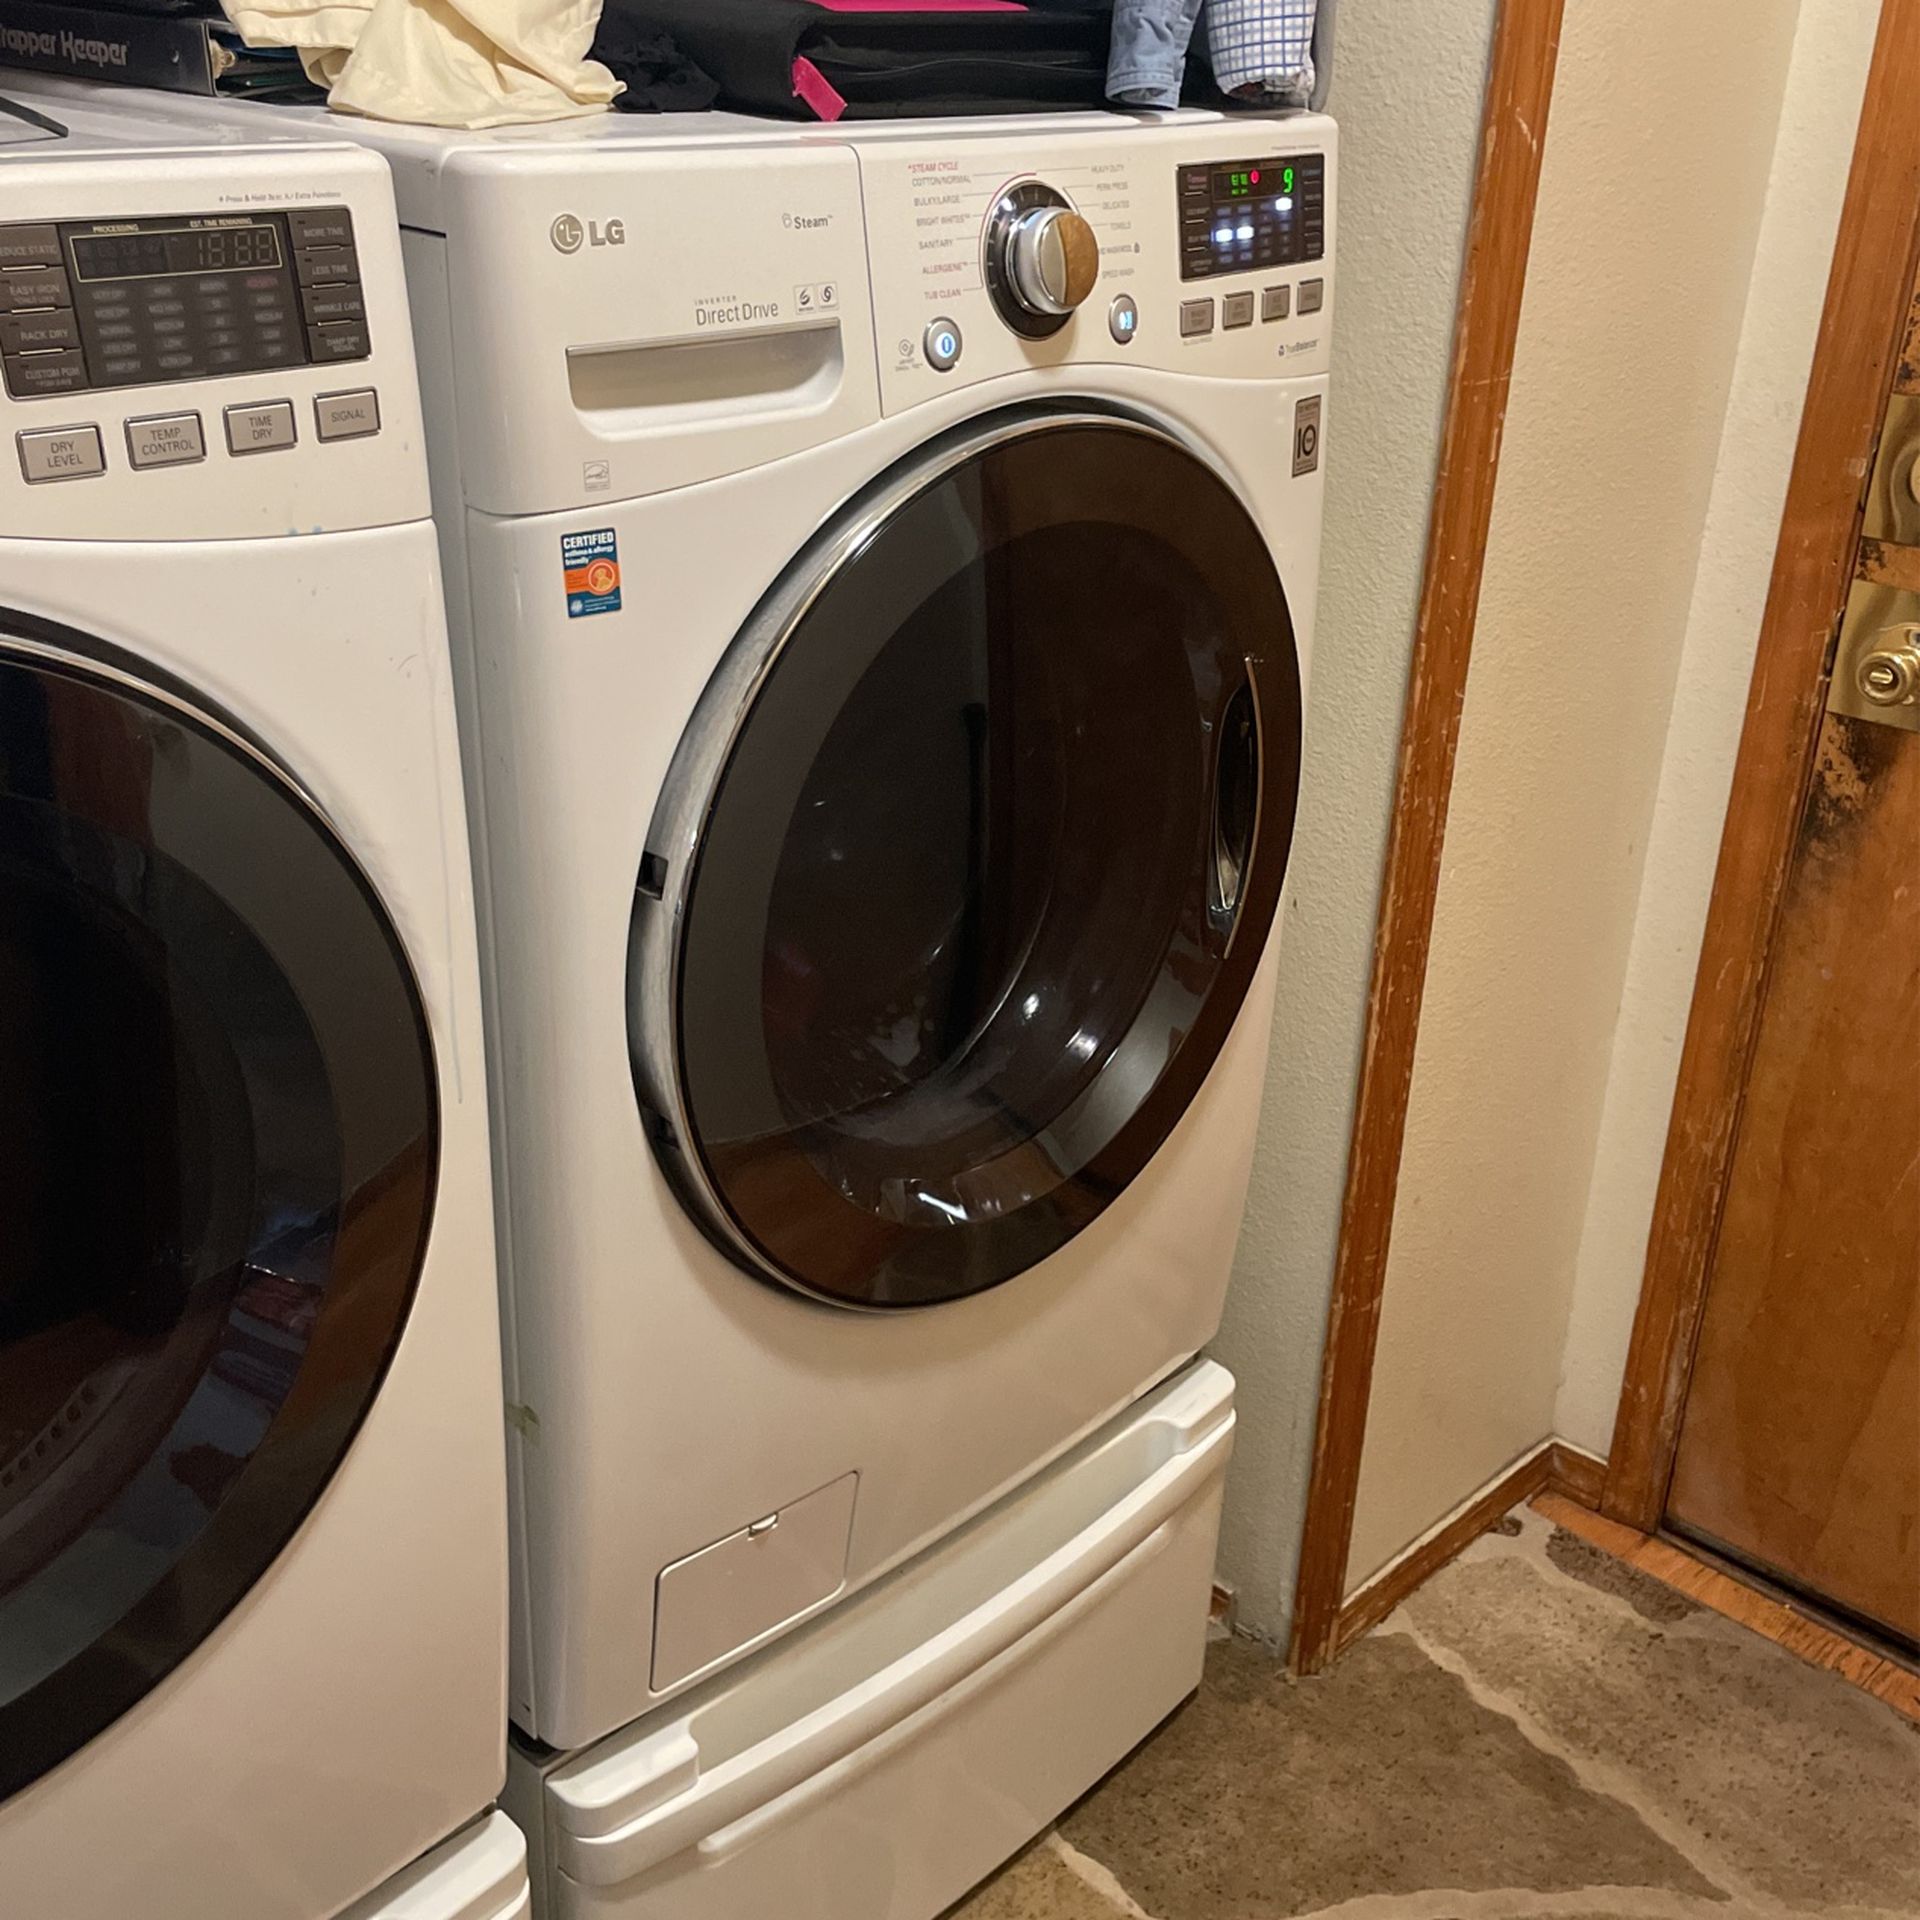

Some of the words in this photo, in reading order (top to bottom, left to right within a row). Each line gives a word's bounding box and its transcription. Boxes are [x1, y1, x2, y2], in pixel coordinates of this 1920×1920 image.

[0, 22, 56, 57] rapper
[60, 30, 127, 68] Keeper
[1283, 167, 1294, 193] 9
[589, 219, 625, 246] LG
[696, 305, 741, 326] Direct
[743, 301, 779, 321] Drive
[249, 415, 272, 428] TIME
[331, 408, 366, 423] SIGNAL
[151, 427, 181, 441] TEMP
[252, 428, 273, 441] DRY
[50, 441, 75, 454] DRY
[142, 440, 195, 456] CONTROL
[47, 454, 83, 468] LEVEL
[563, 531, 614, 550] CERTIFIED
